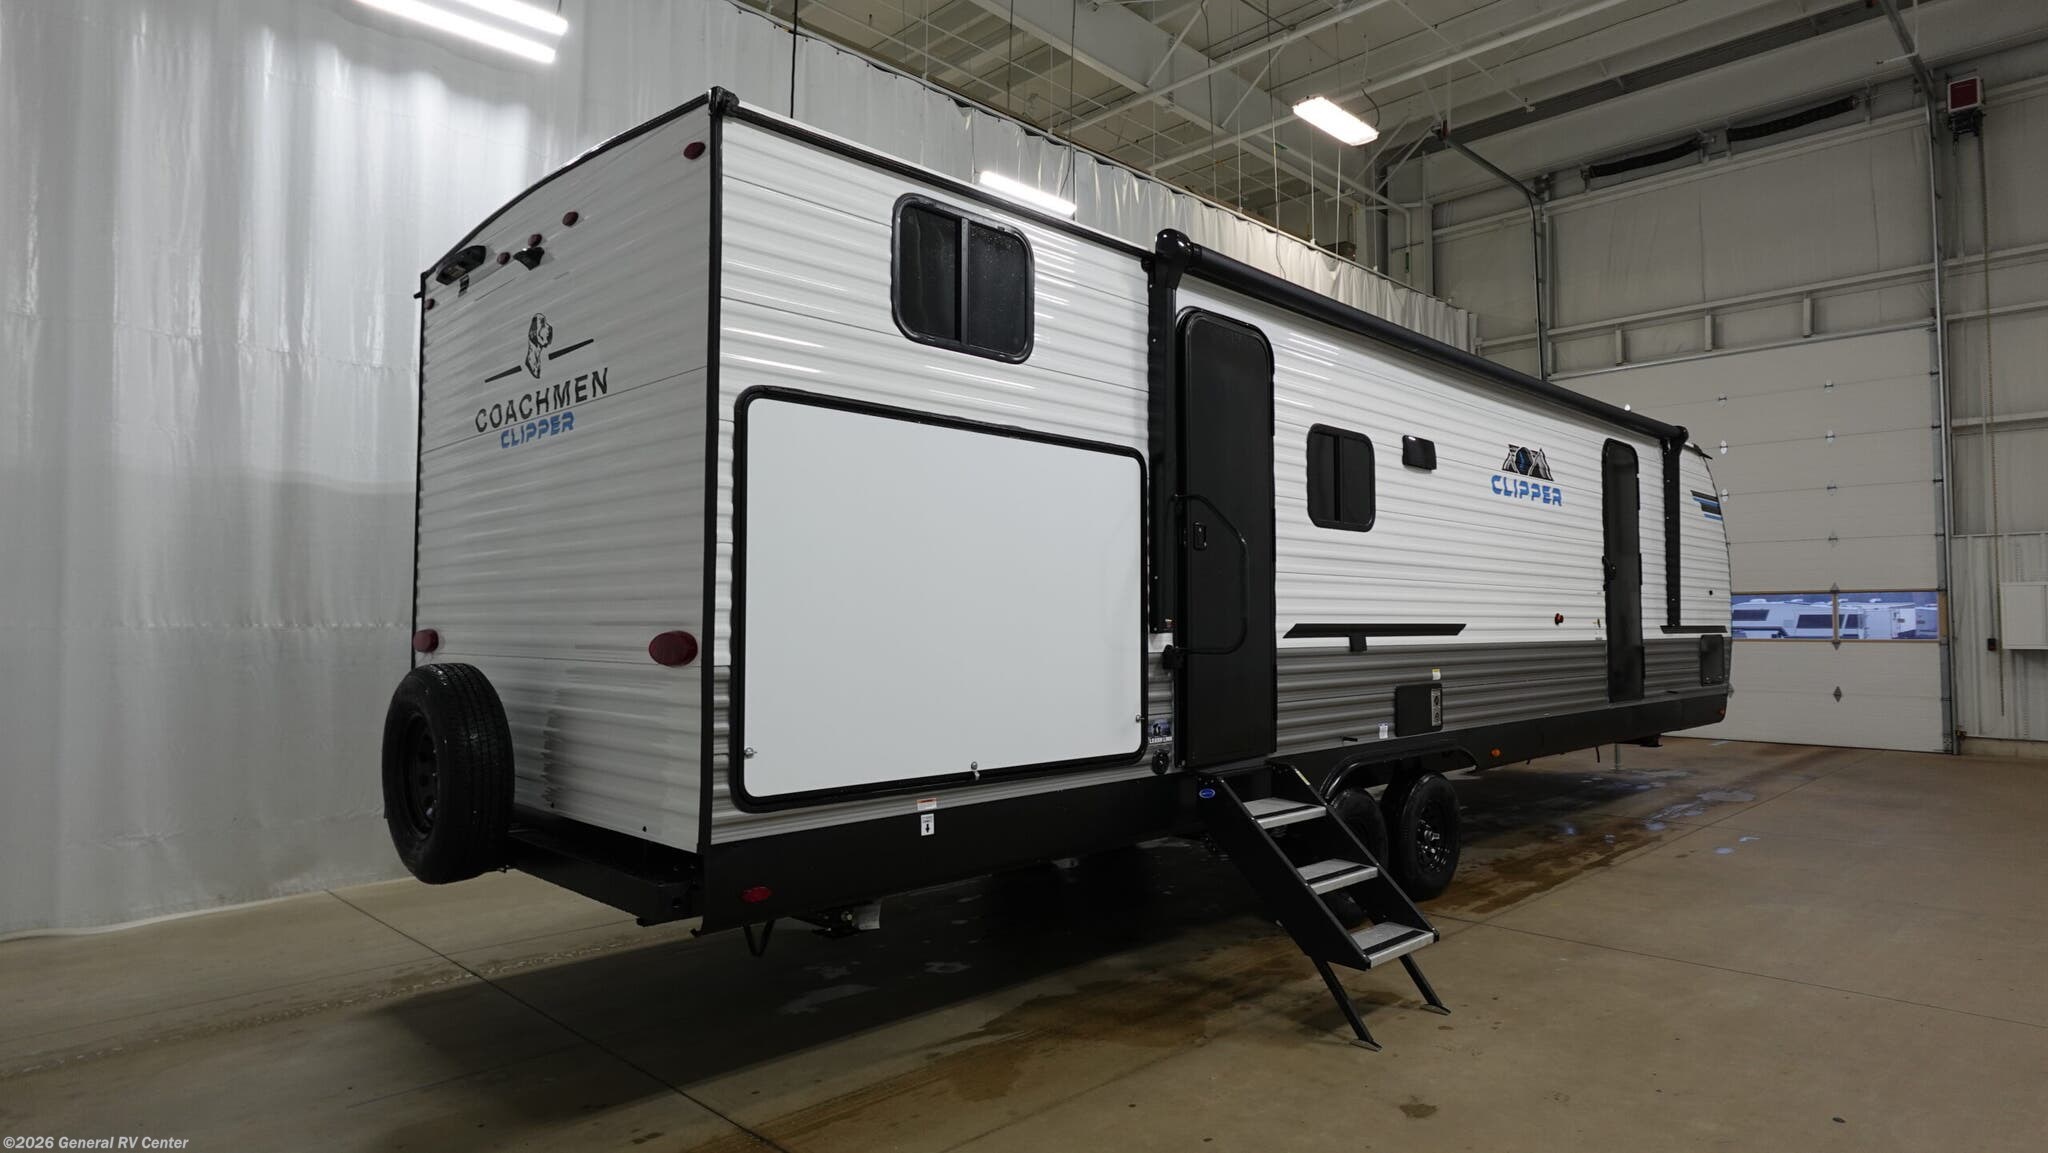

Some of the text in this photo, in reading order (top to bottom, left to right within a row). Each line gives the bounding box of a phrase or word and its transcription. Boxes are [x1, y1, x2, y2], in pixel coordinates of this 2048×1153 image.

[475, 367, 608, 433] COACHMEN
[500, 411, 575, 449] CLIPPER
[1491, 474, 1562, 507] CLIPPER
